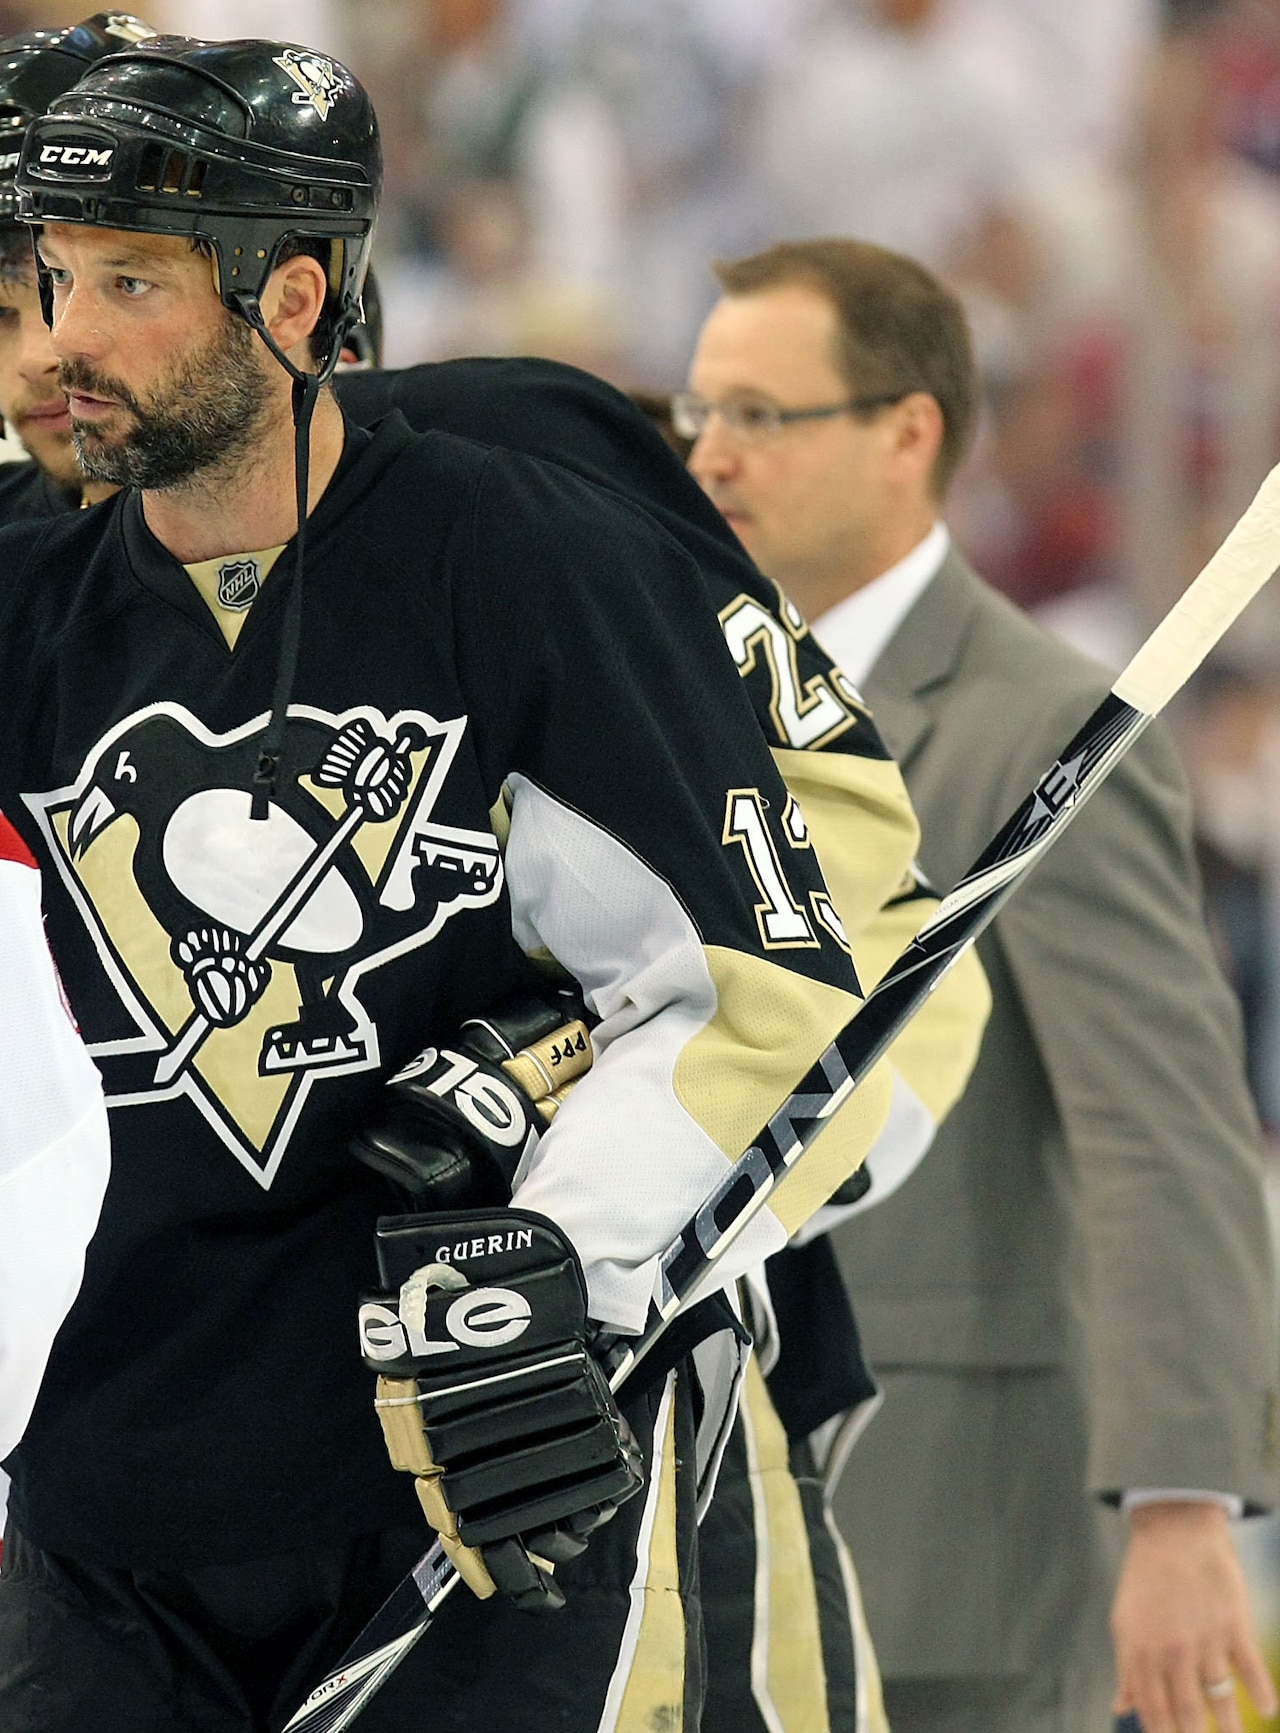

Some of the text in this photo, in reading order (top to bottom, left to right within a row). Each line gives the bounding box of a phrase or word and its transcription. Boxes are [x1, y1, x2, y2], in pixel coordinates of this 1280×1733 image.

[40, 145, 114, 166] CCM
[225, 568, 253, 601] NHL
[551, 1030, 587, 1067] PPF
[434, 1228, 534, 1265] GUERIN
